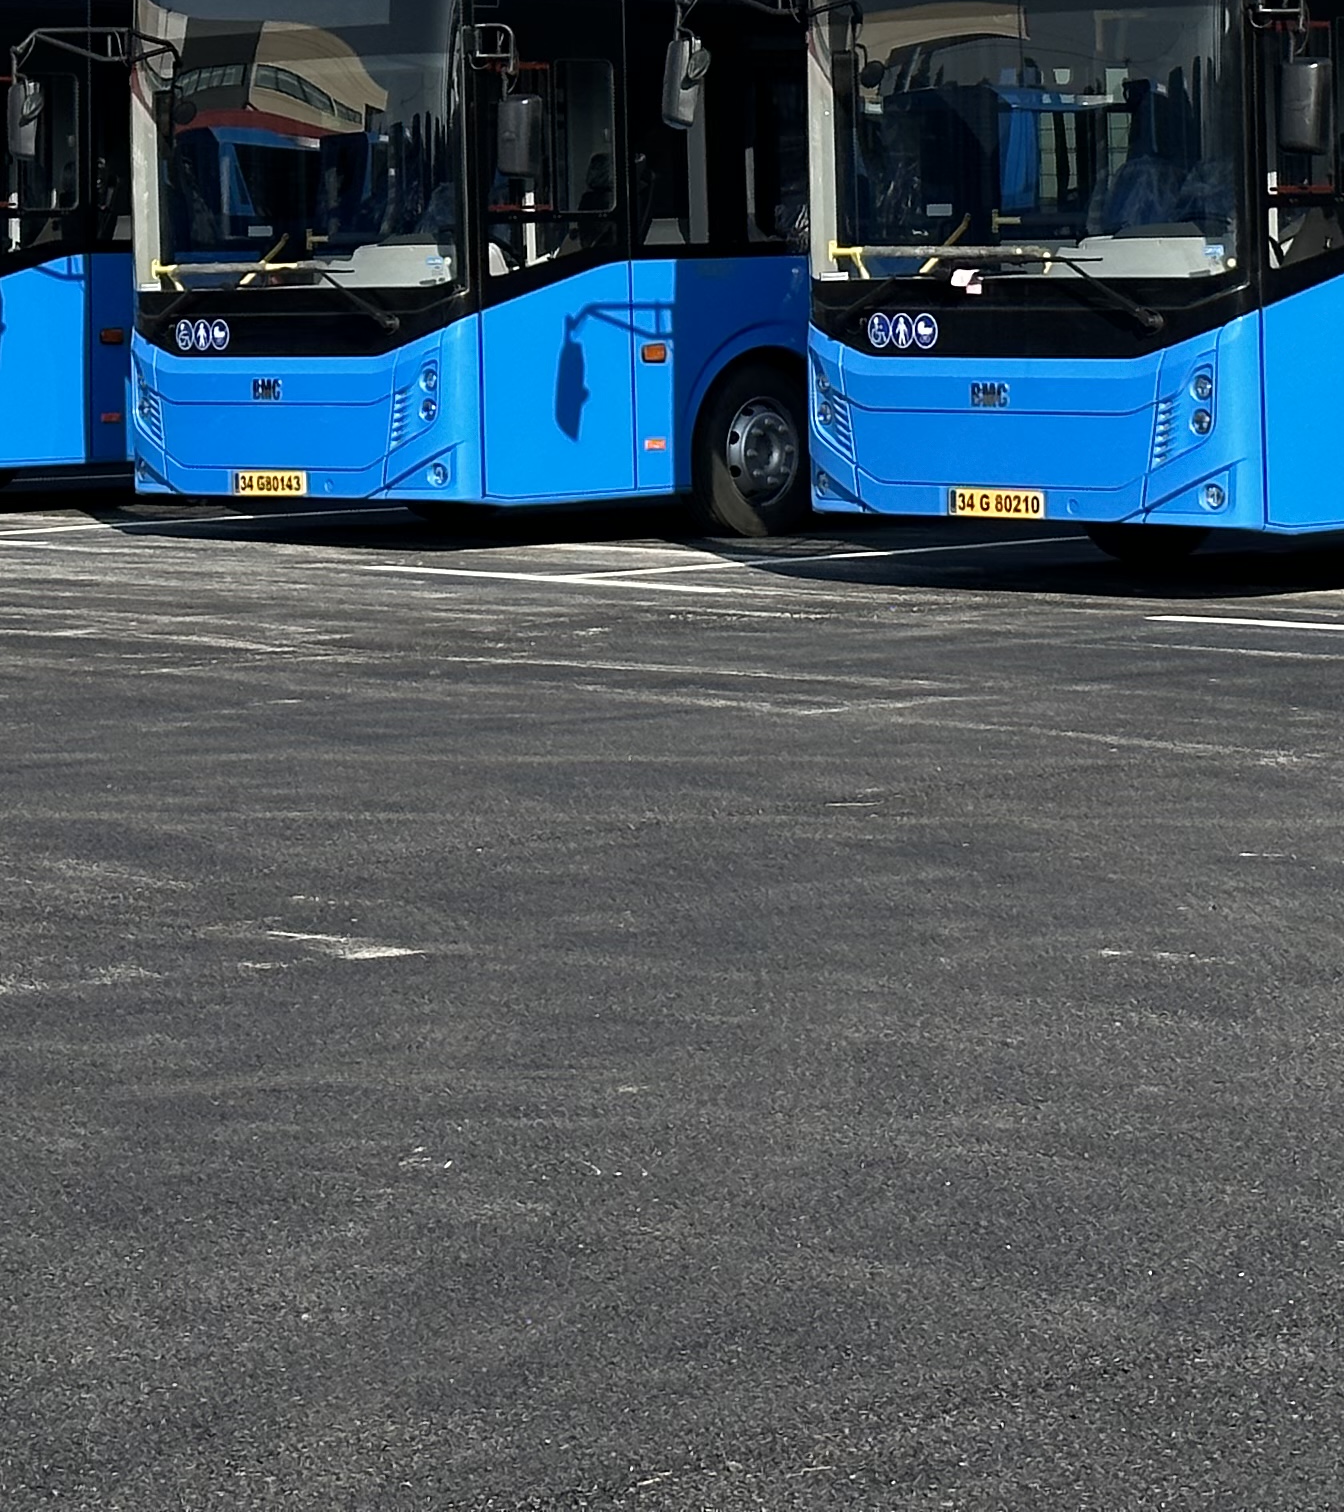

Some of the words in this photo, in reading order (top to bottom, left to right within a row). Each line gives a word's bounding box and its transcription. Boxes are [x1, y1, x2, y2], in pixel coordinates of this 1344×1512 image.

[252, 378, 282, 400] BMC
[970, 382, 1008, 407] BMC
[240, 475, 254, 491] 34
[958, 493, 975, 511] 34
[980, 494, 990, 511] G
[995, 494, 1040, 514] 80210
